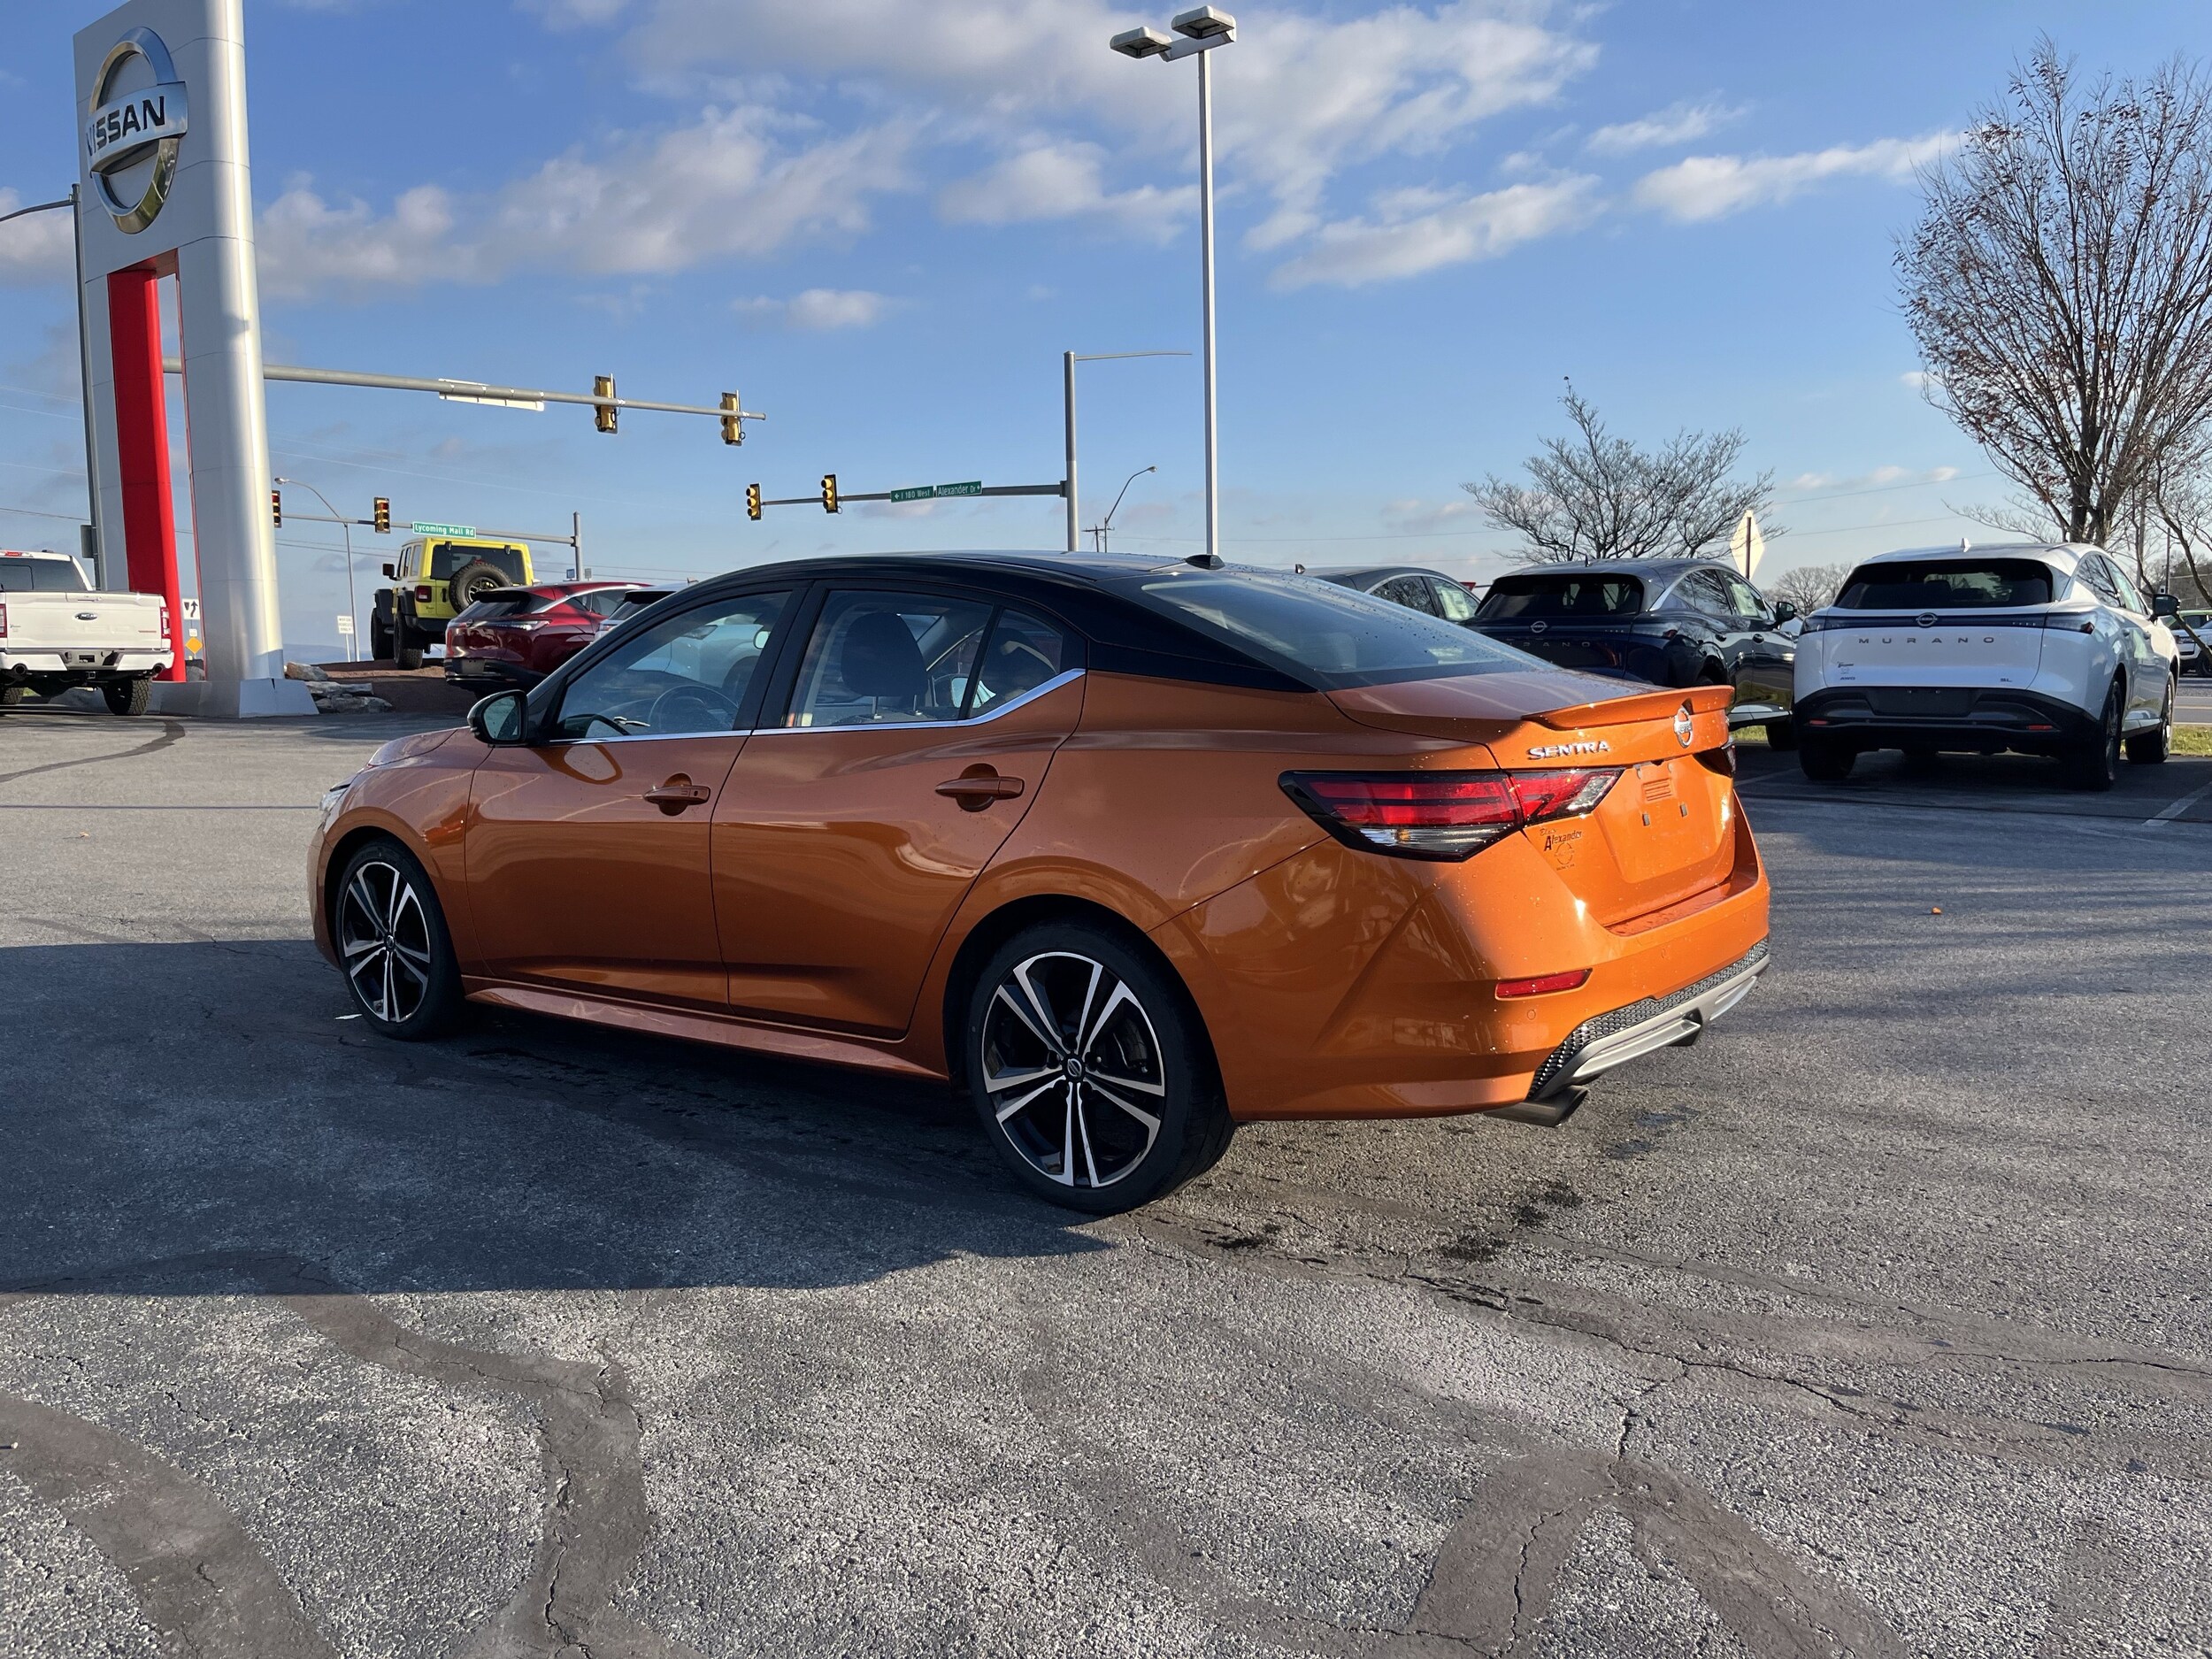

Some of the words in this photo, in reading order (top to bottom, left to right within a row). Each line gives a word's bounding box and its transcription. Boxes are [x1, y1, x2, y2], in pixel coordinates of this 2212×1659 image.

[86, 96, 165, 157] NISSAN
[905, 490, 916, 499] 180
[938, 484, 968, 496] Alexander
[415, 524, 447, 534] Lycoming
[449, 526, 464, 535] Mall
[1526, 741, 1610, 760] SENTRA
